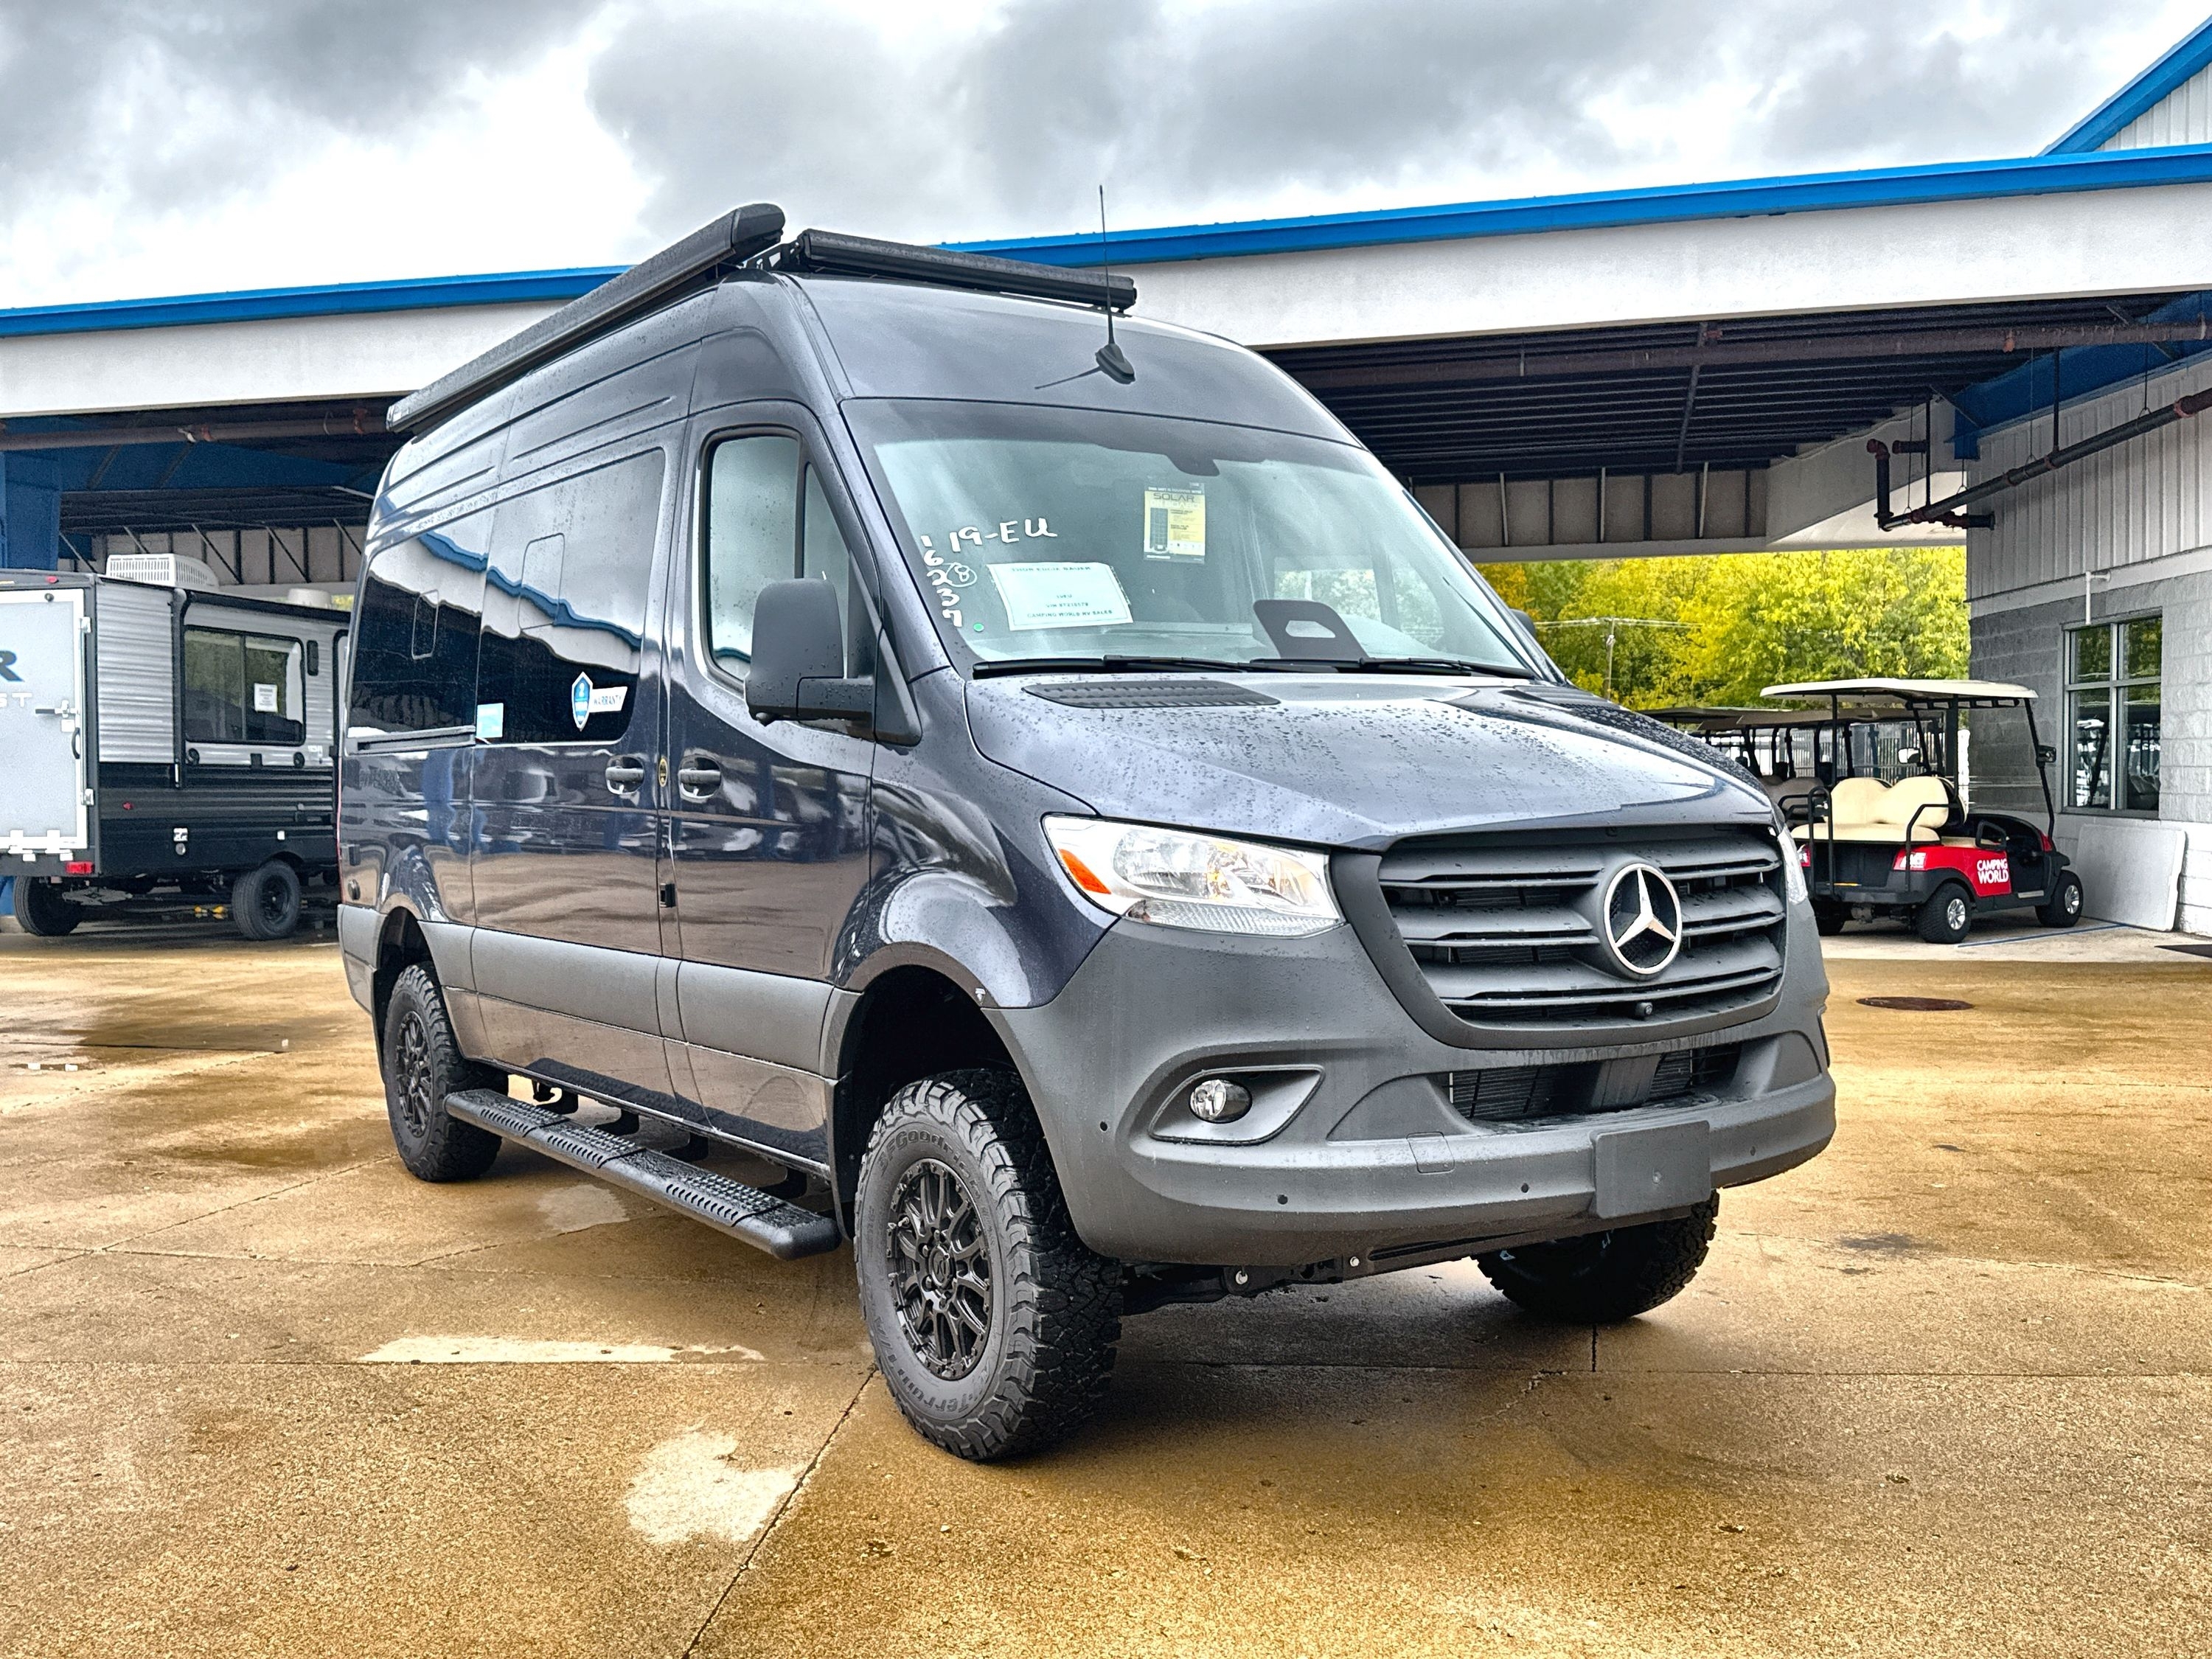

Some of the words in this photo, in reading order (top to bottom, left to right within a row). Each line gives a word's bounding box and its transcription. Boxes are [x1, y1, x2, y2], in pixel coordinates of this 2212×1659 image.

[1153, 493, 1194, 502] SOLAR
[594, 695, 622, 706] WARRANTY
[1977, 858, 2008, 870] CAMPING
[1978, 869, 2008, 884] WORLD
